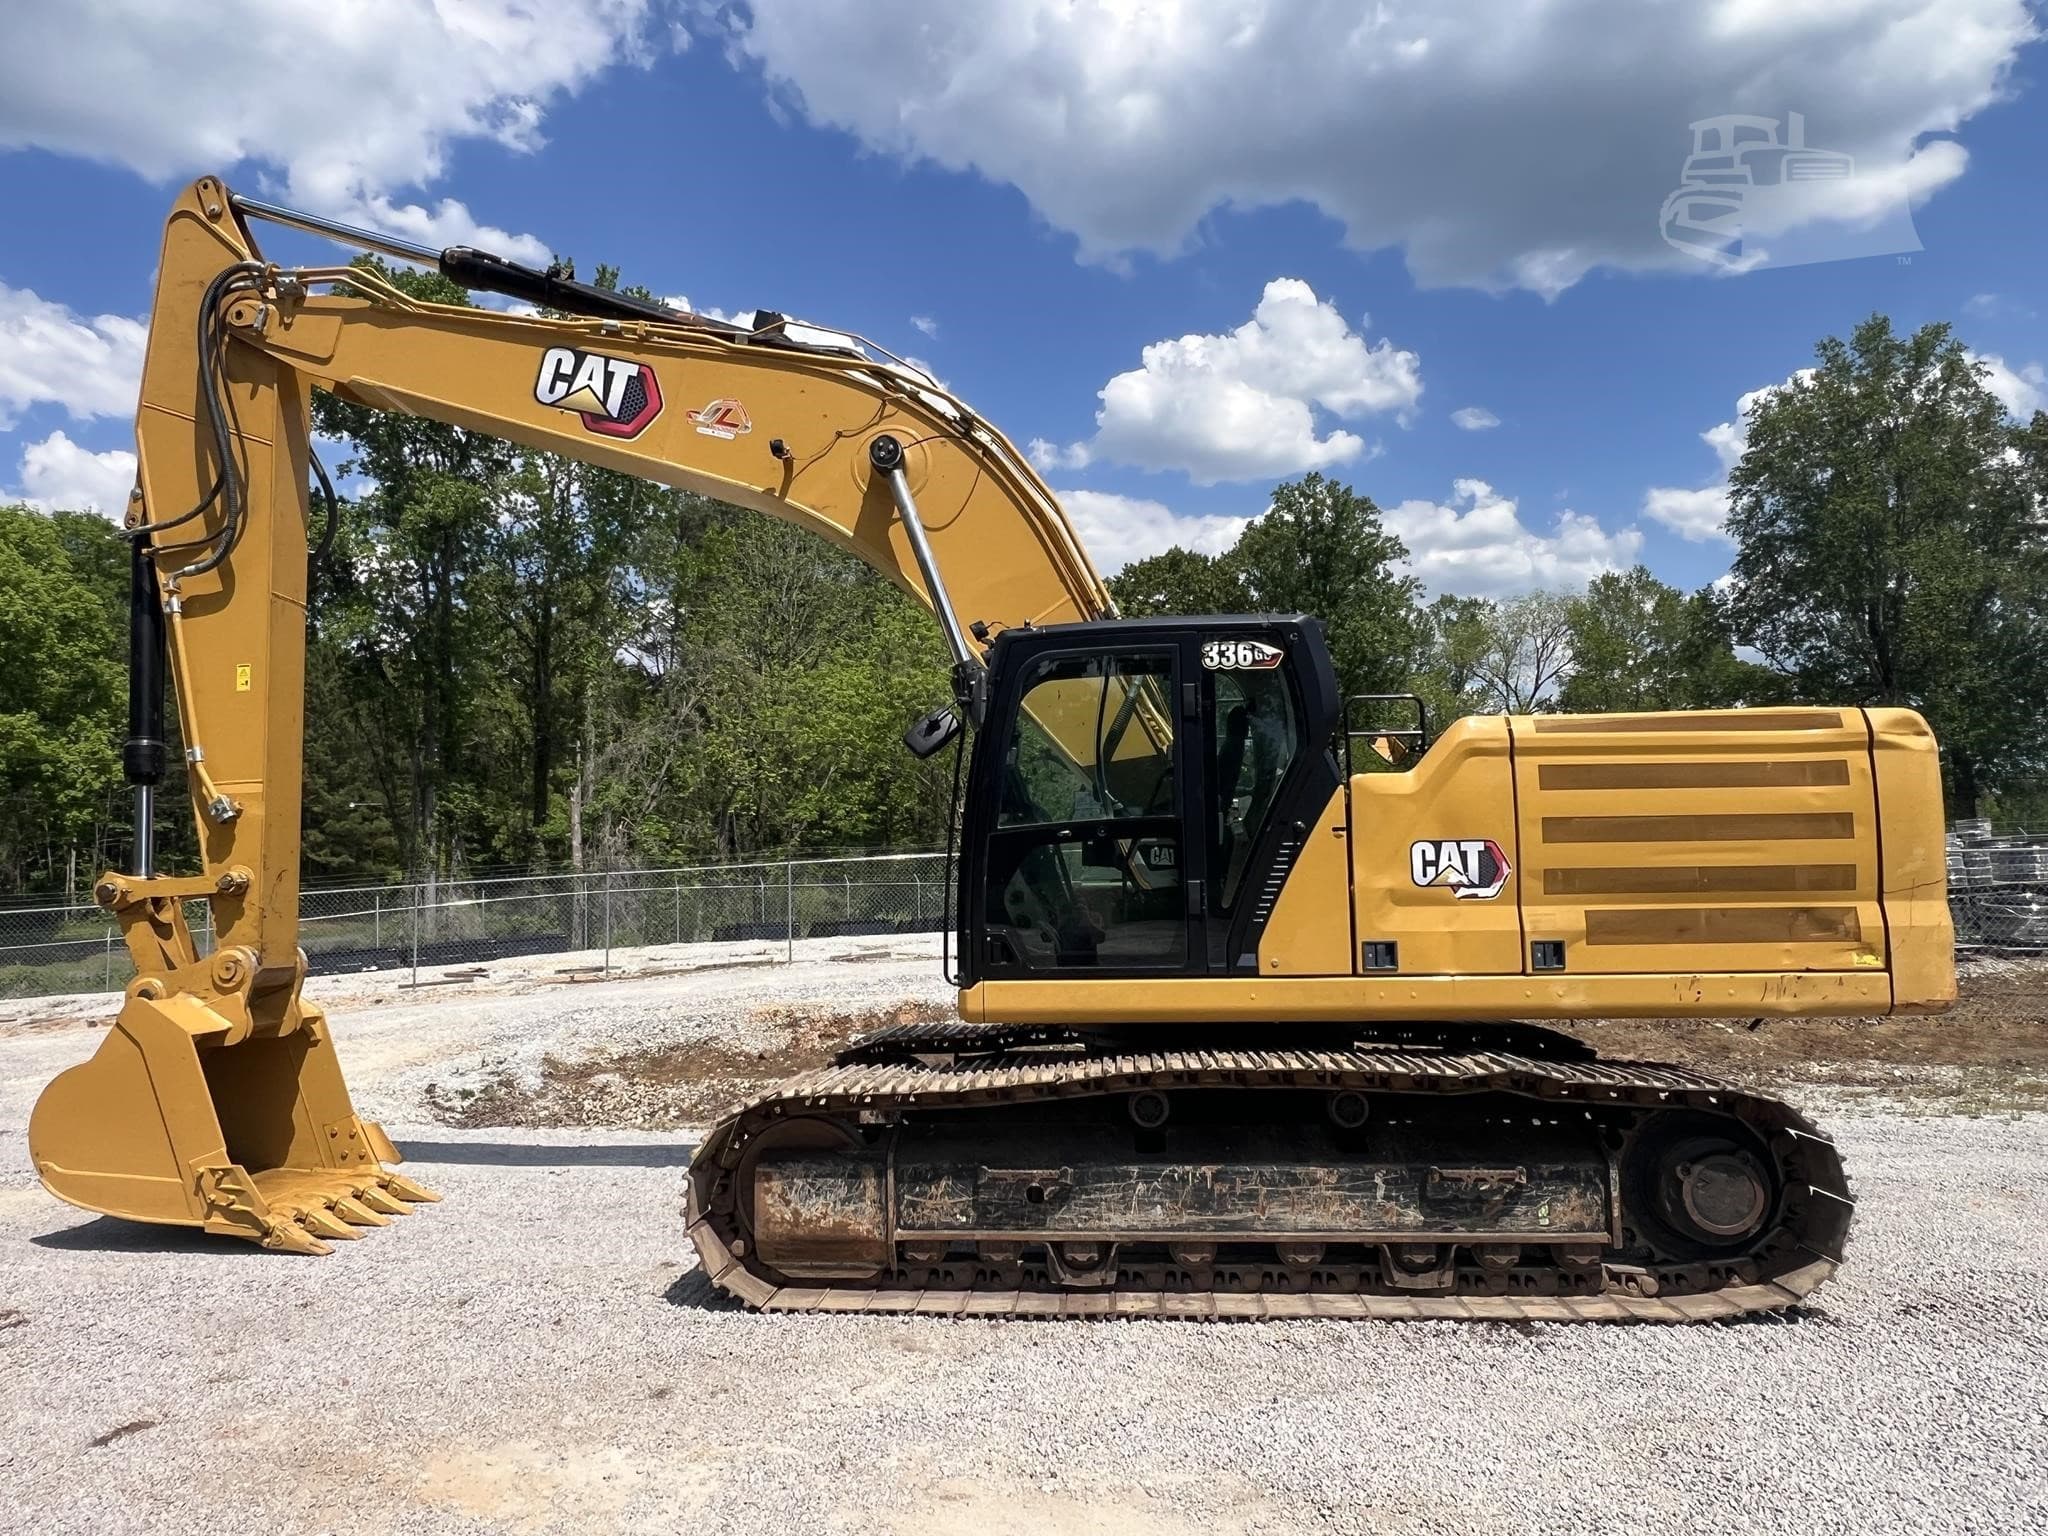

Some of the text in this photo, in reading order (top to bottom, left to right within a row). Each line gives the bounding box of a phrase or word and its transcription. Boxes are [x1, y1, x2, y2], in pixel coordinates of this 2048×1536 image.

[536, 347, 640, 418] CAT
[1203, 643, 1253, 667] 336
[1411, 841, 1485, 886] CAT
